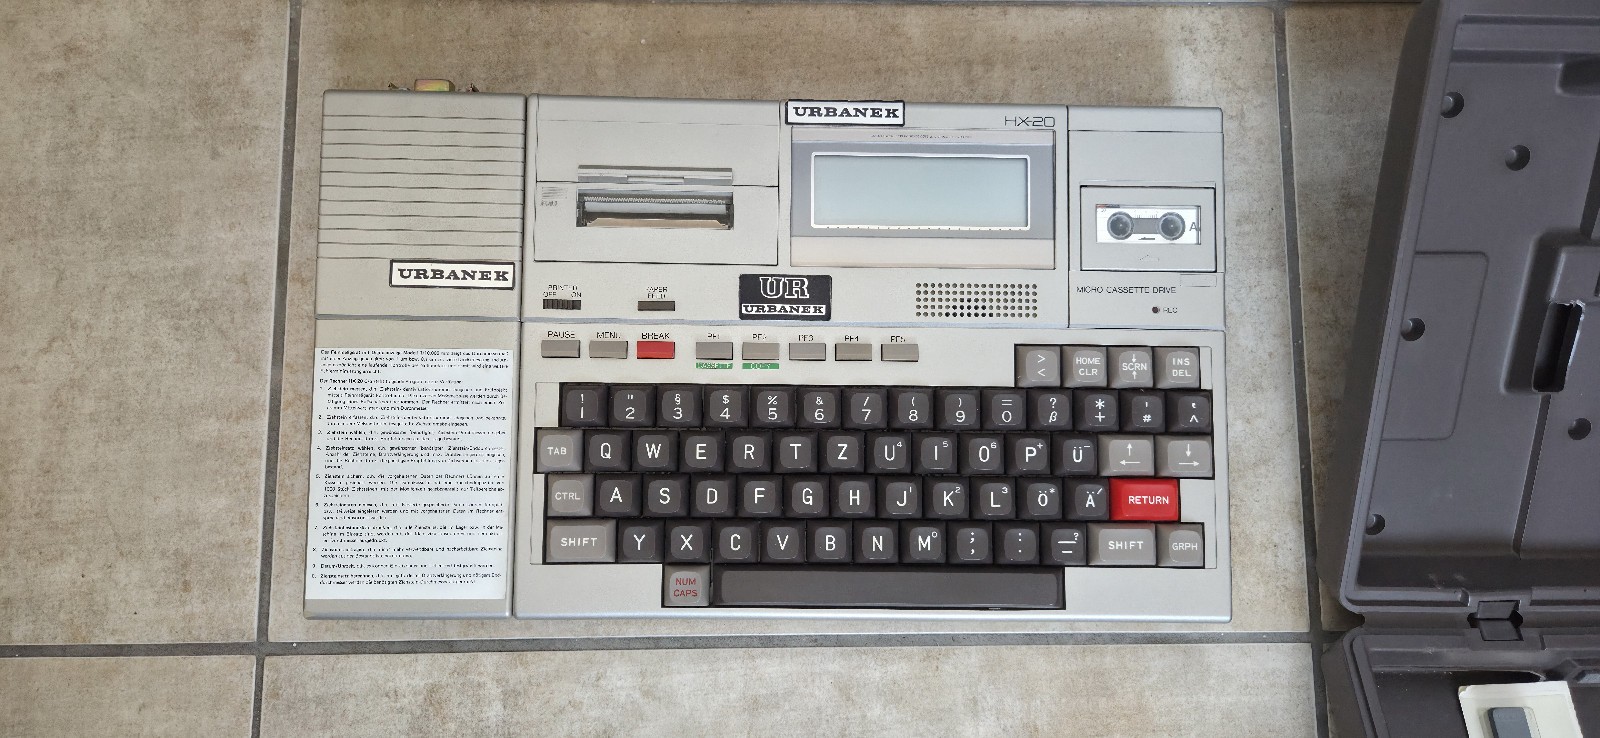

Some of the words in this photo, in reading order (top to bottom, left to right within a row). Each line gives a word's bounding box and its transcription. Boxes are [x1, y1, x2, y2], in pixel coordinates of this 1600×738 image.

[793, 106, 900, 119] URBANEK
[1004, 115, 1056, 128] HX-20
[398, 268, 509, 282] URBANEK
[759, 276, 810, 299] UR
[1106, 286, 1150, 294] CASSETTE
[1152, 286, 1177, 294] DRIVE
[743, 304, 824, 314] URBANEK
[547, 330, 576, 339] PAUSE
[641, 332, 670, 340] BREAK
[1121, 362, 1148, 372] SCRN
[675, 394, 680, 405] §
[723, 395, 729, 404] $
[768, 396, 777, 404] %
[816, 397, 823, 405] &
[1050, 398, 1056, 408] ?
[626, 407, 634, 419] 2
[673, 407, 682, 419] 3
[720, 408, 730, 419] 4
[768, 408, 777, 420] 5
[815, 409, 824, 420] 6
[862, 409, 871, 421] 7
[909, 410, 918, 421] 8
[956, 411, 965, 422] 9
[547, 447, 566, 455] TAB
[601, 443, 611, 459] Q
[646, 443, 661, 458] W
[696, 444, 706, 459] E
[745, 444, 754, 459] R
[790, 444, 801, 459] T
[838, 444, 847, 459] Z
[555, 492, 580, 500] CTRL
[610, 487, 622, 502] A
[660, 488, 670, 504] S
[707, 488, 717, 504] D
[755, 488, 765, 503] F
[803, 488, 812, 505] G
[850, 490, 859, 505] H
[1128, 495, 1170, 505] RETURN
[561, 538, 597, 546] SHIFT
[634, 535, 645, 550] Y
[681, 534, 692, 550] X
[731, 534, 740, 550] C
[777, 535, 788, 550] V
[826, 535, 835, 550] B
[873, 536, 882, 551] N
[1109, 541, 1143, 549] SHIFT
[675, 578, 697, 586] NUM
[673, 590, 698, 598] CAPS
